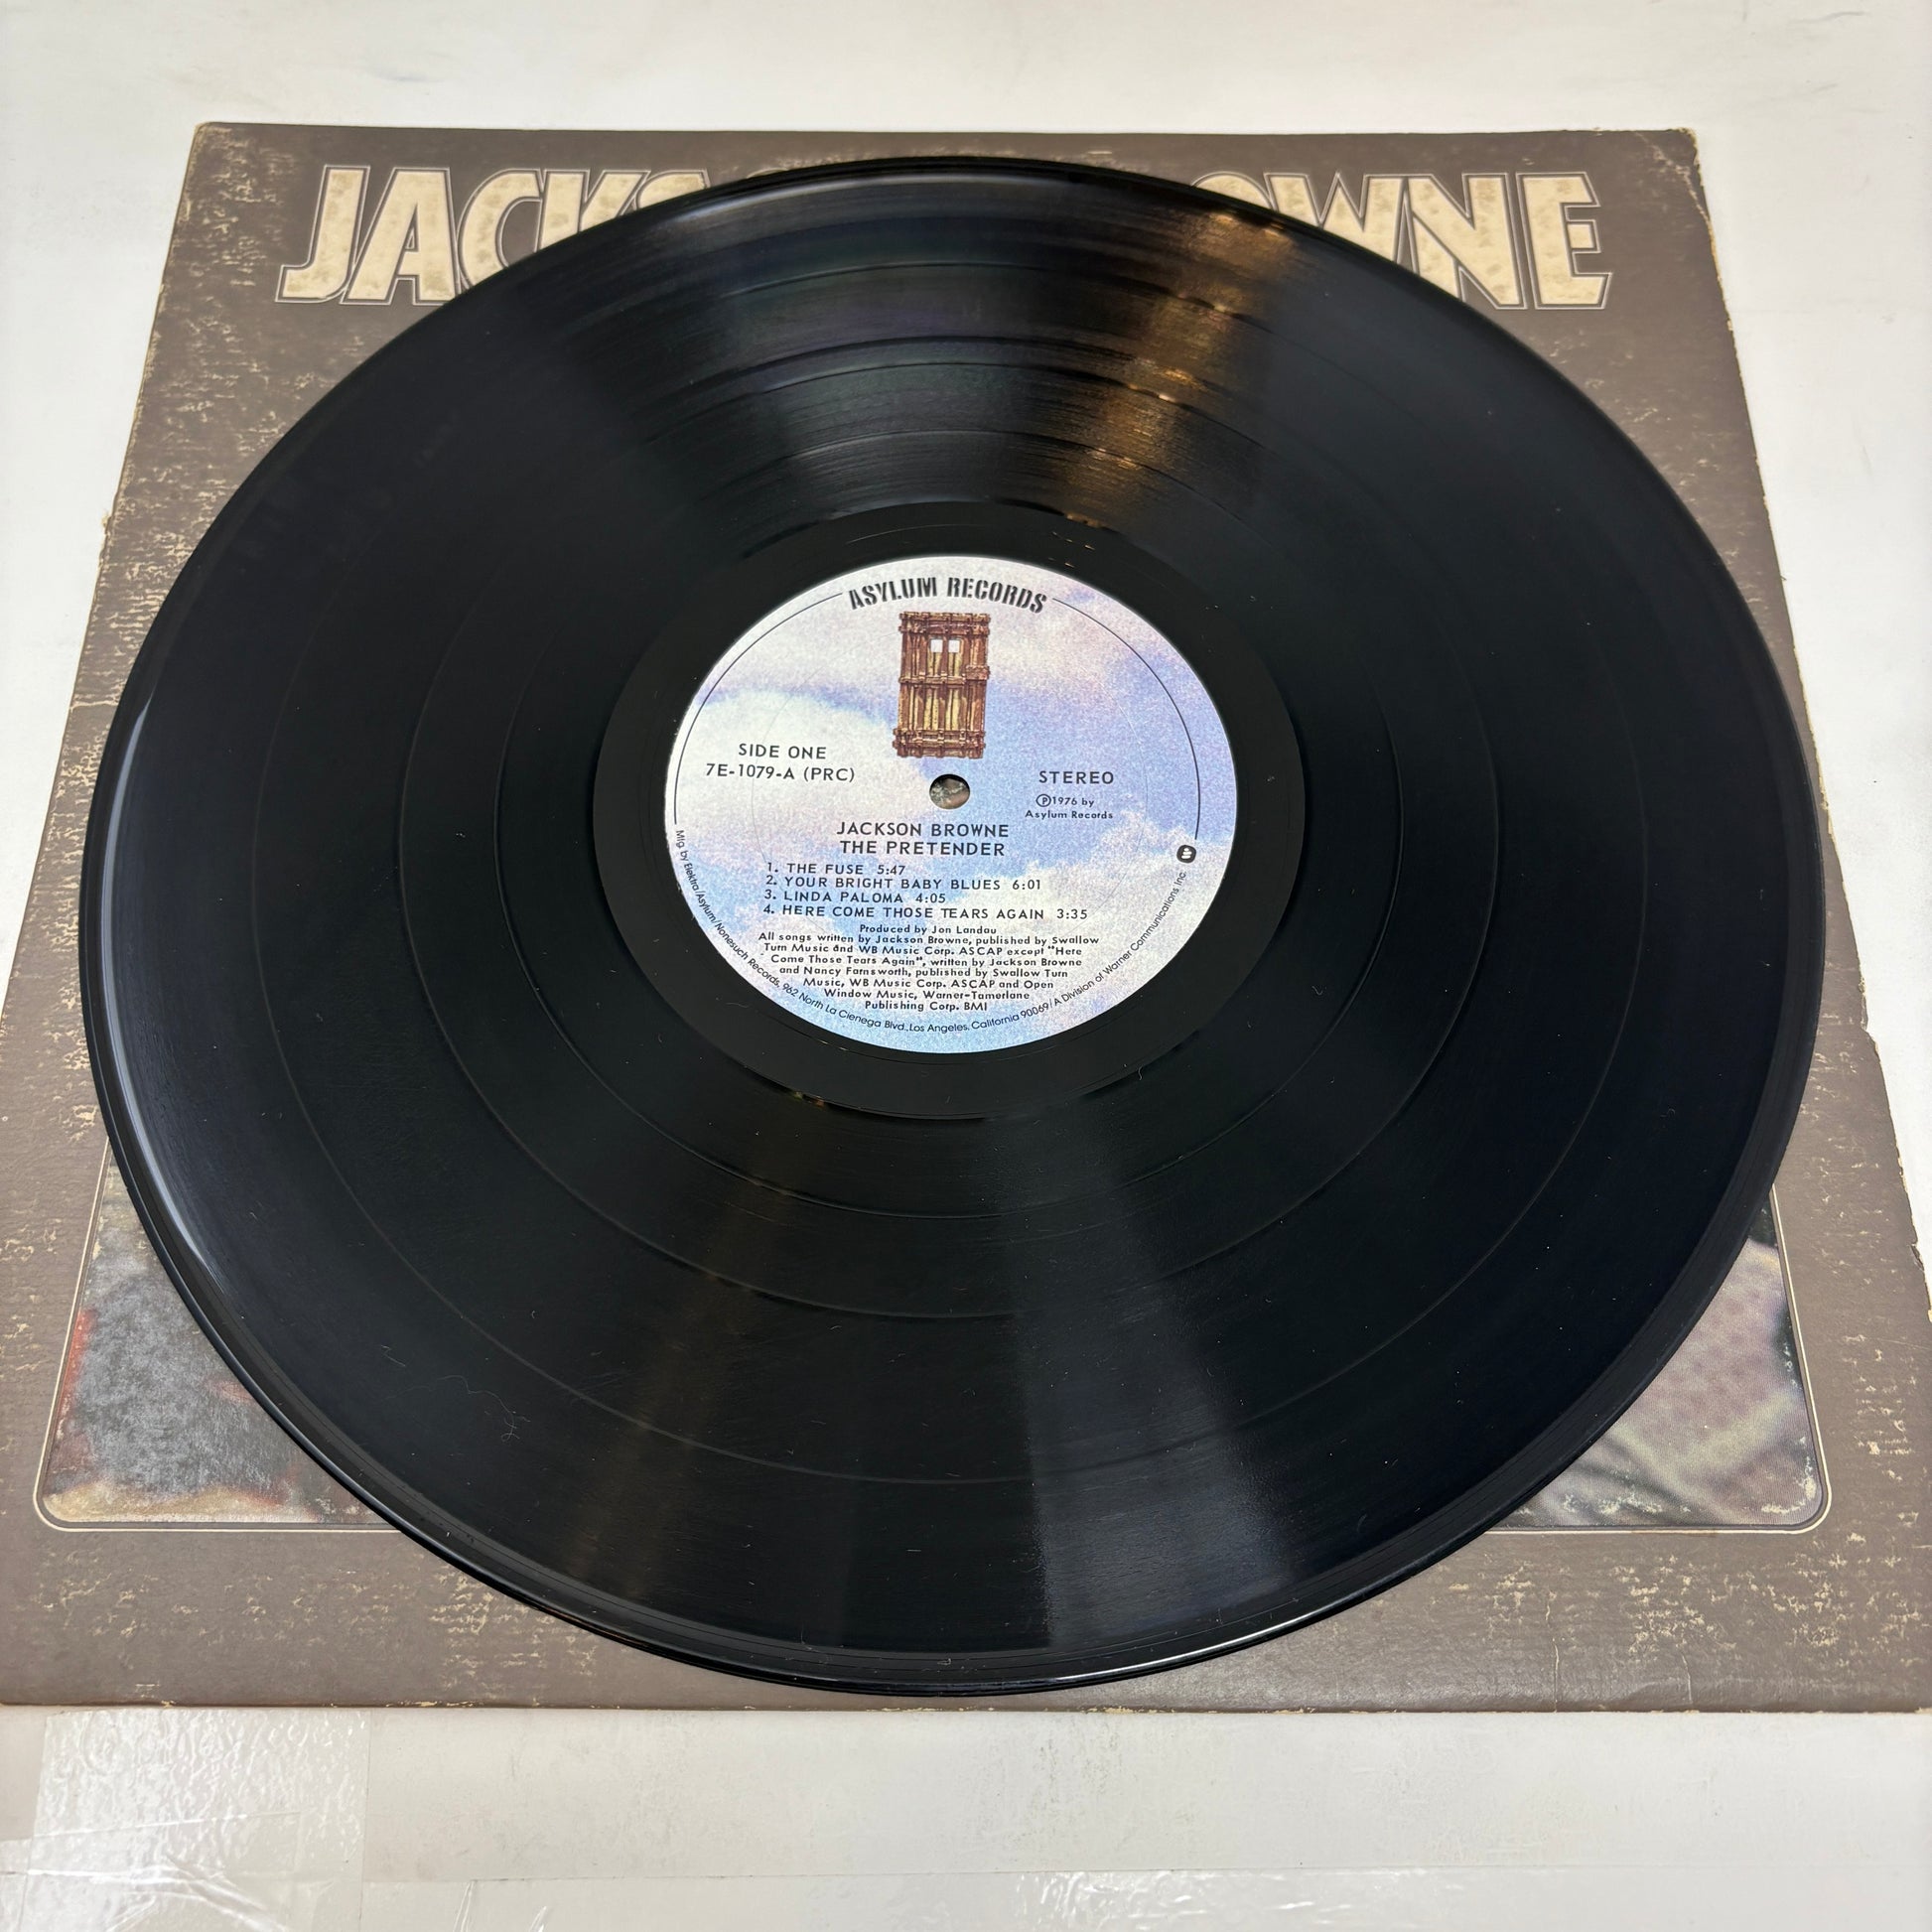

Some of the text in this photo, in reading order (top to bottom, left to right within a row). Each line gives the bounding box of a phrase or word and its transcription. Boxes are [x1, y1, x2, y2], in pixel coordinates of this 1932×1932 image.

[848, 576, 1047, 614] ASYLUM RECORDS
[739, 743, 827, 759] SIDE ONE
[705, 762, 855, 782] 7E-1079-A (PRC)
[1038, 770, 1114, 784] STEREO
[1081, 796, 1095, 808] by
[1025, 810, 1114, 820] Asylum Records
[836, 822, 1009, 838] JACKSON BROWNE
[840, 840, 1005, 856] THE PRETENDER
[766, 862, 905, 876] 1. THE FUSE 5:47
[765, 874, 1040, 891] 2. YOUR BRIGHT BABY BLUES 6:01
[764, 890, 946, 903] 3. LINDA PALOMA 4:05
[762, 903, 1088, 919] 4. HERE COME THOSE TEARS AGAIN 3:35
[859, 924, 997, 935] Produced by Jon Landau
[759, 931, 1100, 947] All songs written by Jackson Browne, published by Swallow
[763, 943, 787, 952] Turn
[790, 943, 829, 952] Music
[832, 943, 854, 953] and
[858, 945, 878, 954] WB
[882, 945, 919, 955] Music
[924, 947, 955, 957] Corp.
[959, 947, 1003, 956] ASCAP
[1007, 947, 1044, 958] except
[770, 954, 804, 963] Come
[808, 955, 842, 964] Those
[847, 956, 877, 965] Tears
[930, 958, 968, 967] written
[971, 958, 985, 968] by
[989, 957, 1036, 967] Jackson
[1040, 957, 1082, 967] Browne
[778, 965, 799, 975] and
[803, 967, 842, 977] Nancy
[846, 967, 911, 977] Farnsworth,
[915, 969, 971, 979] published
[975, 969, 988, 979] by
[1044, 969, 1068, 978] Turn
[747, 957, 780, 988] Records,
[782, 983, 799, 997] 962
[798, 992, 824, 1010] North
[825, 1004, 838, 1015] La
[838, 1009, 882, 1029] Cienega
[971, 1013, 1020, 1030] California
[1060, 980, 1095, 1003] Division
[1095, 972, 1104, 983] of
[1102, 950, 1133, 975] Warner
[802, 978, 1054, 990] Music, WB Music Corp. ASCAP and Open
[824, 989, 1031, 1000] Window Music, Warner-Tamerlane
[865, 1000, 924, 1012] Publishing
[929, 1001, 960, 1012] Corp.
